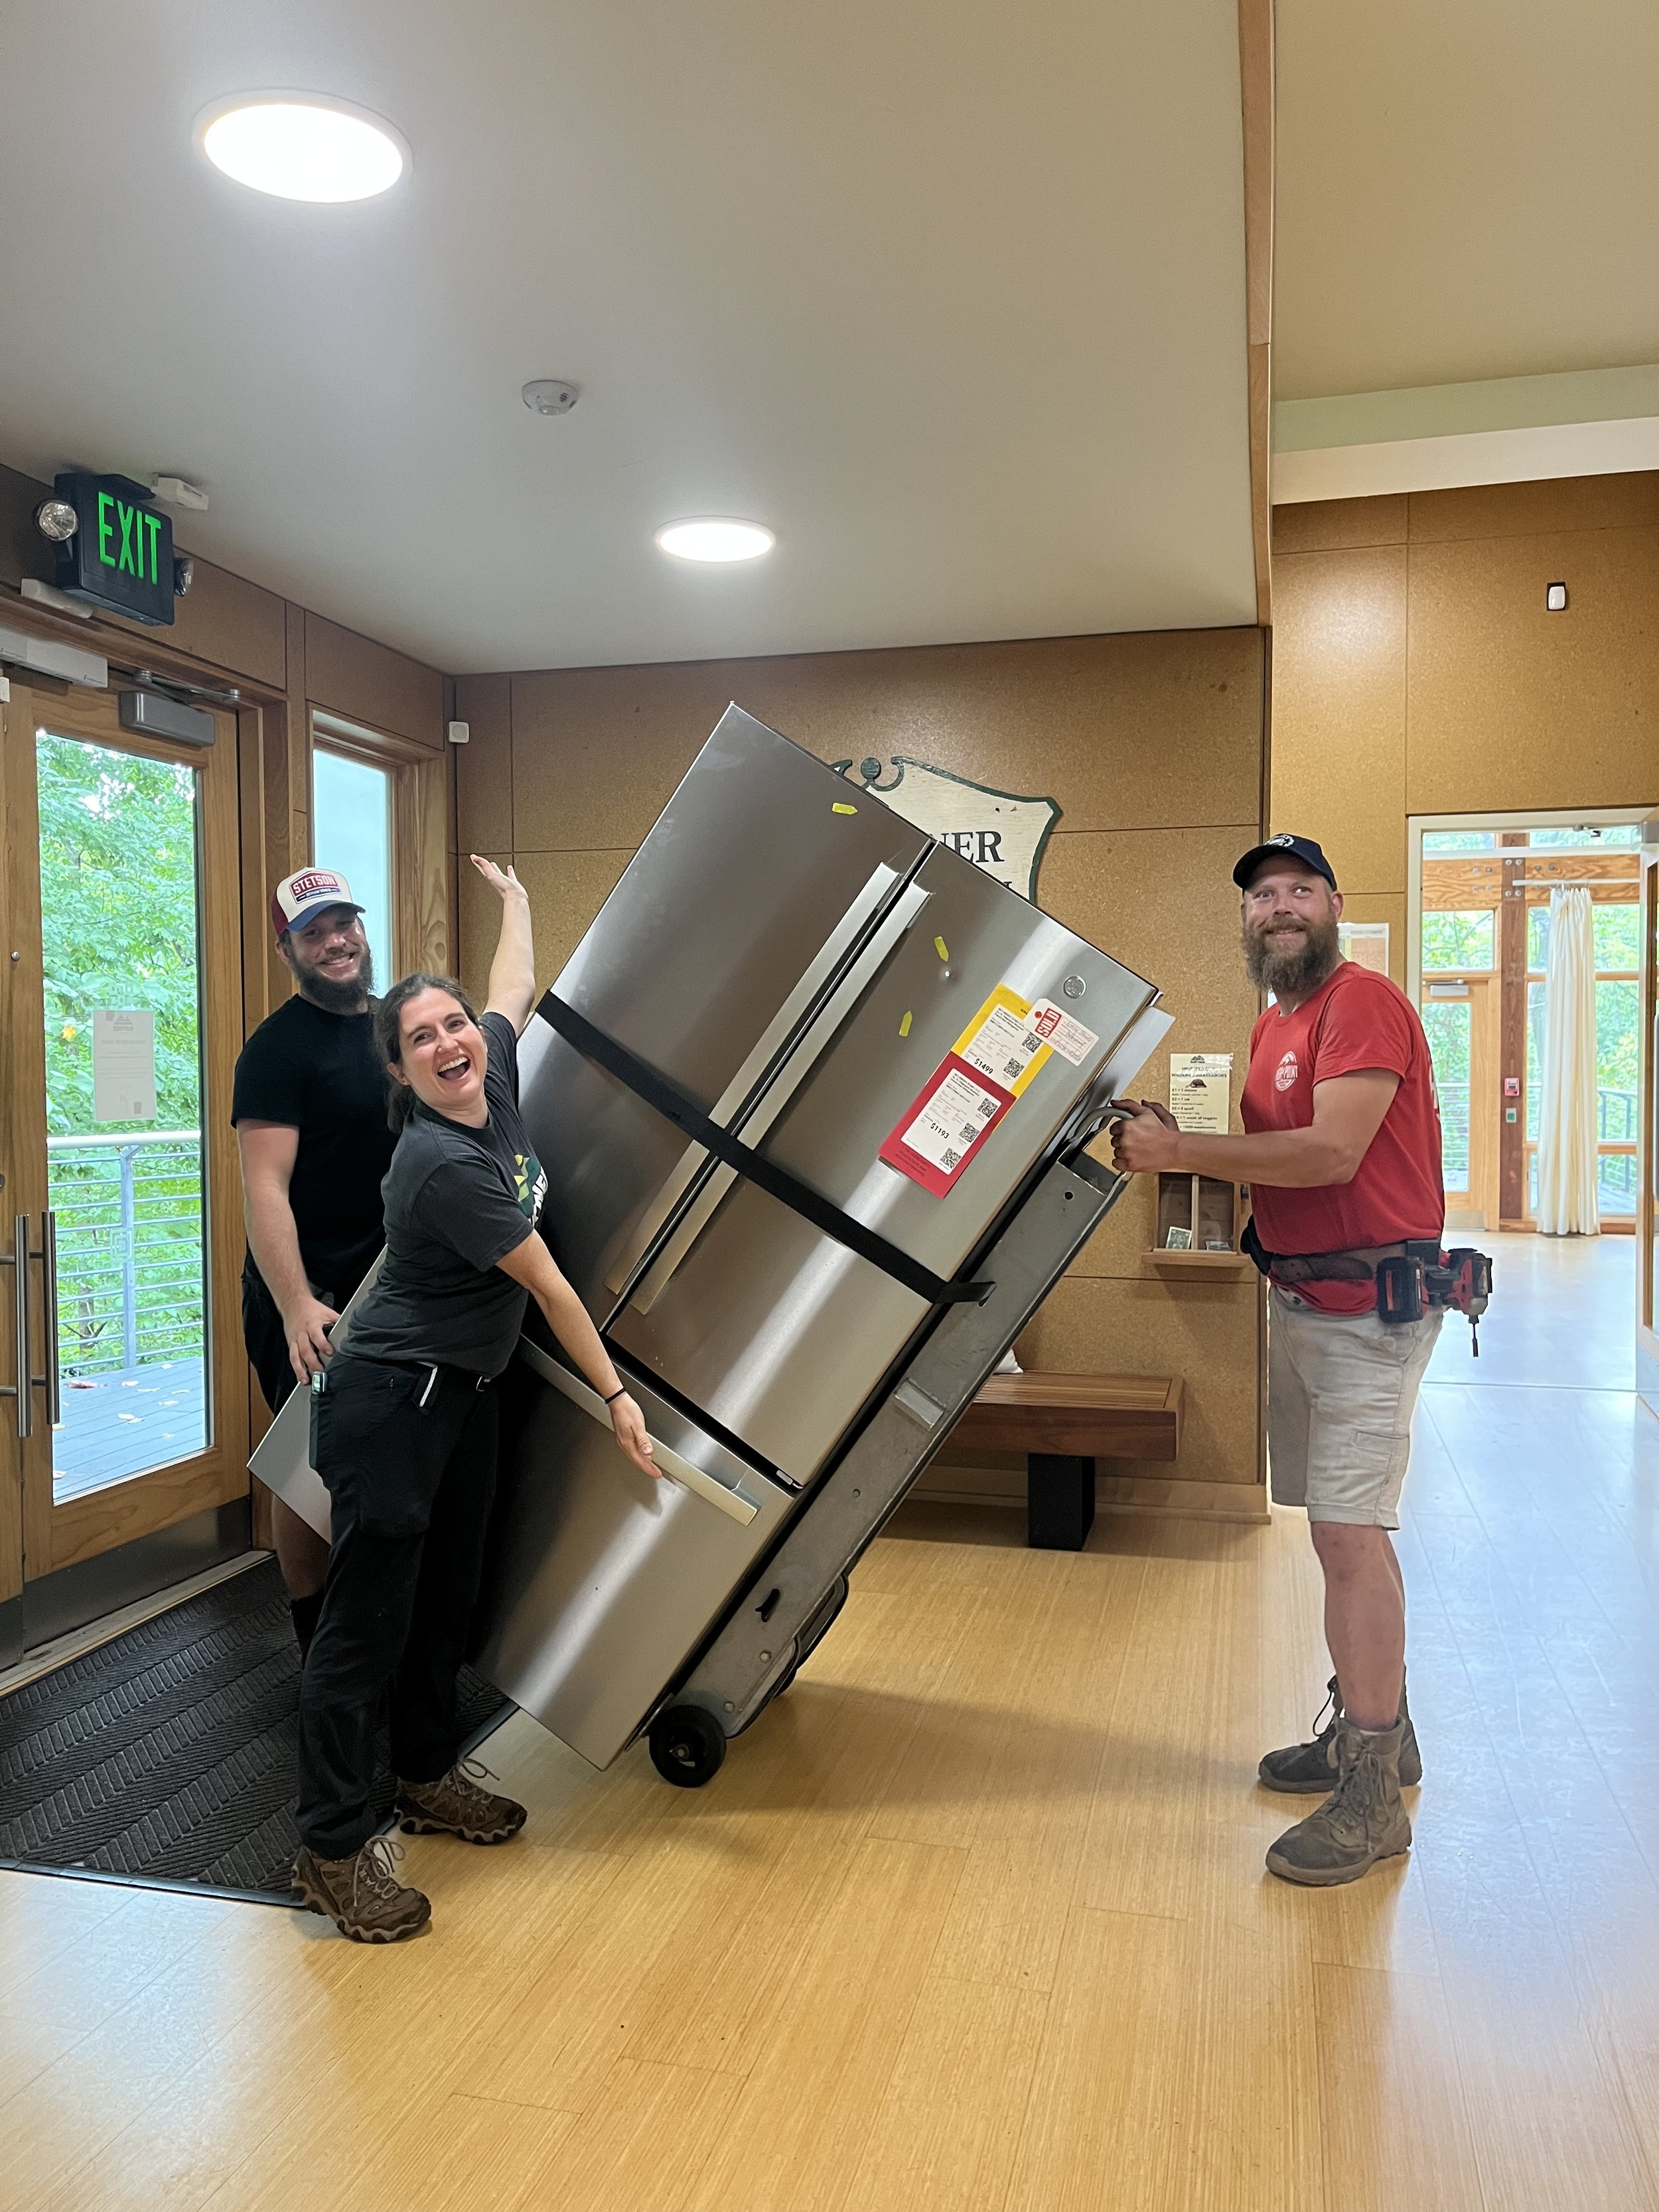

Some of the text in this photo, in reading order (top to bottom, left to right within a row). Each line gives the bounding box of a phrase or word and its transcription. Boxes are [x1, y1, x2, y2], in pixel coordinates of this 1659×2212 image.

[98, 491, 161, 585] EXIT
[930, 831, 1005, 863] ER
[293, 875, 336, 894] STETSON
[1036, 1009, 1061, 1037] SOLD
[974, 1058, 994, 1074] $1499
[930, 1122, 950, 1140] $1193
